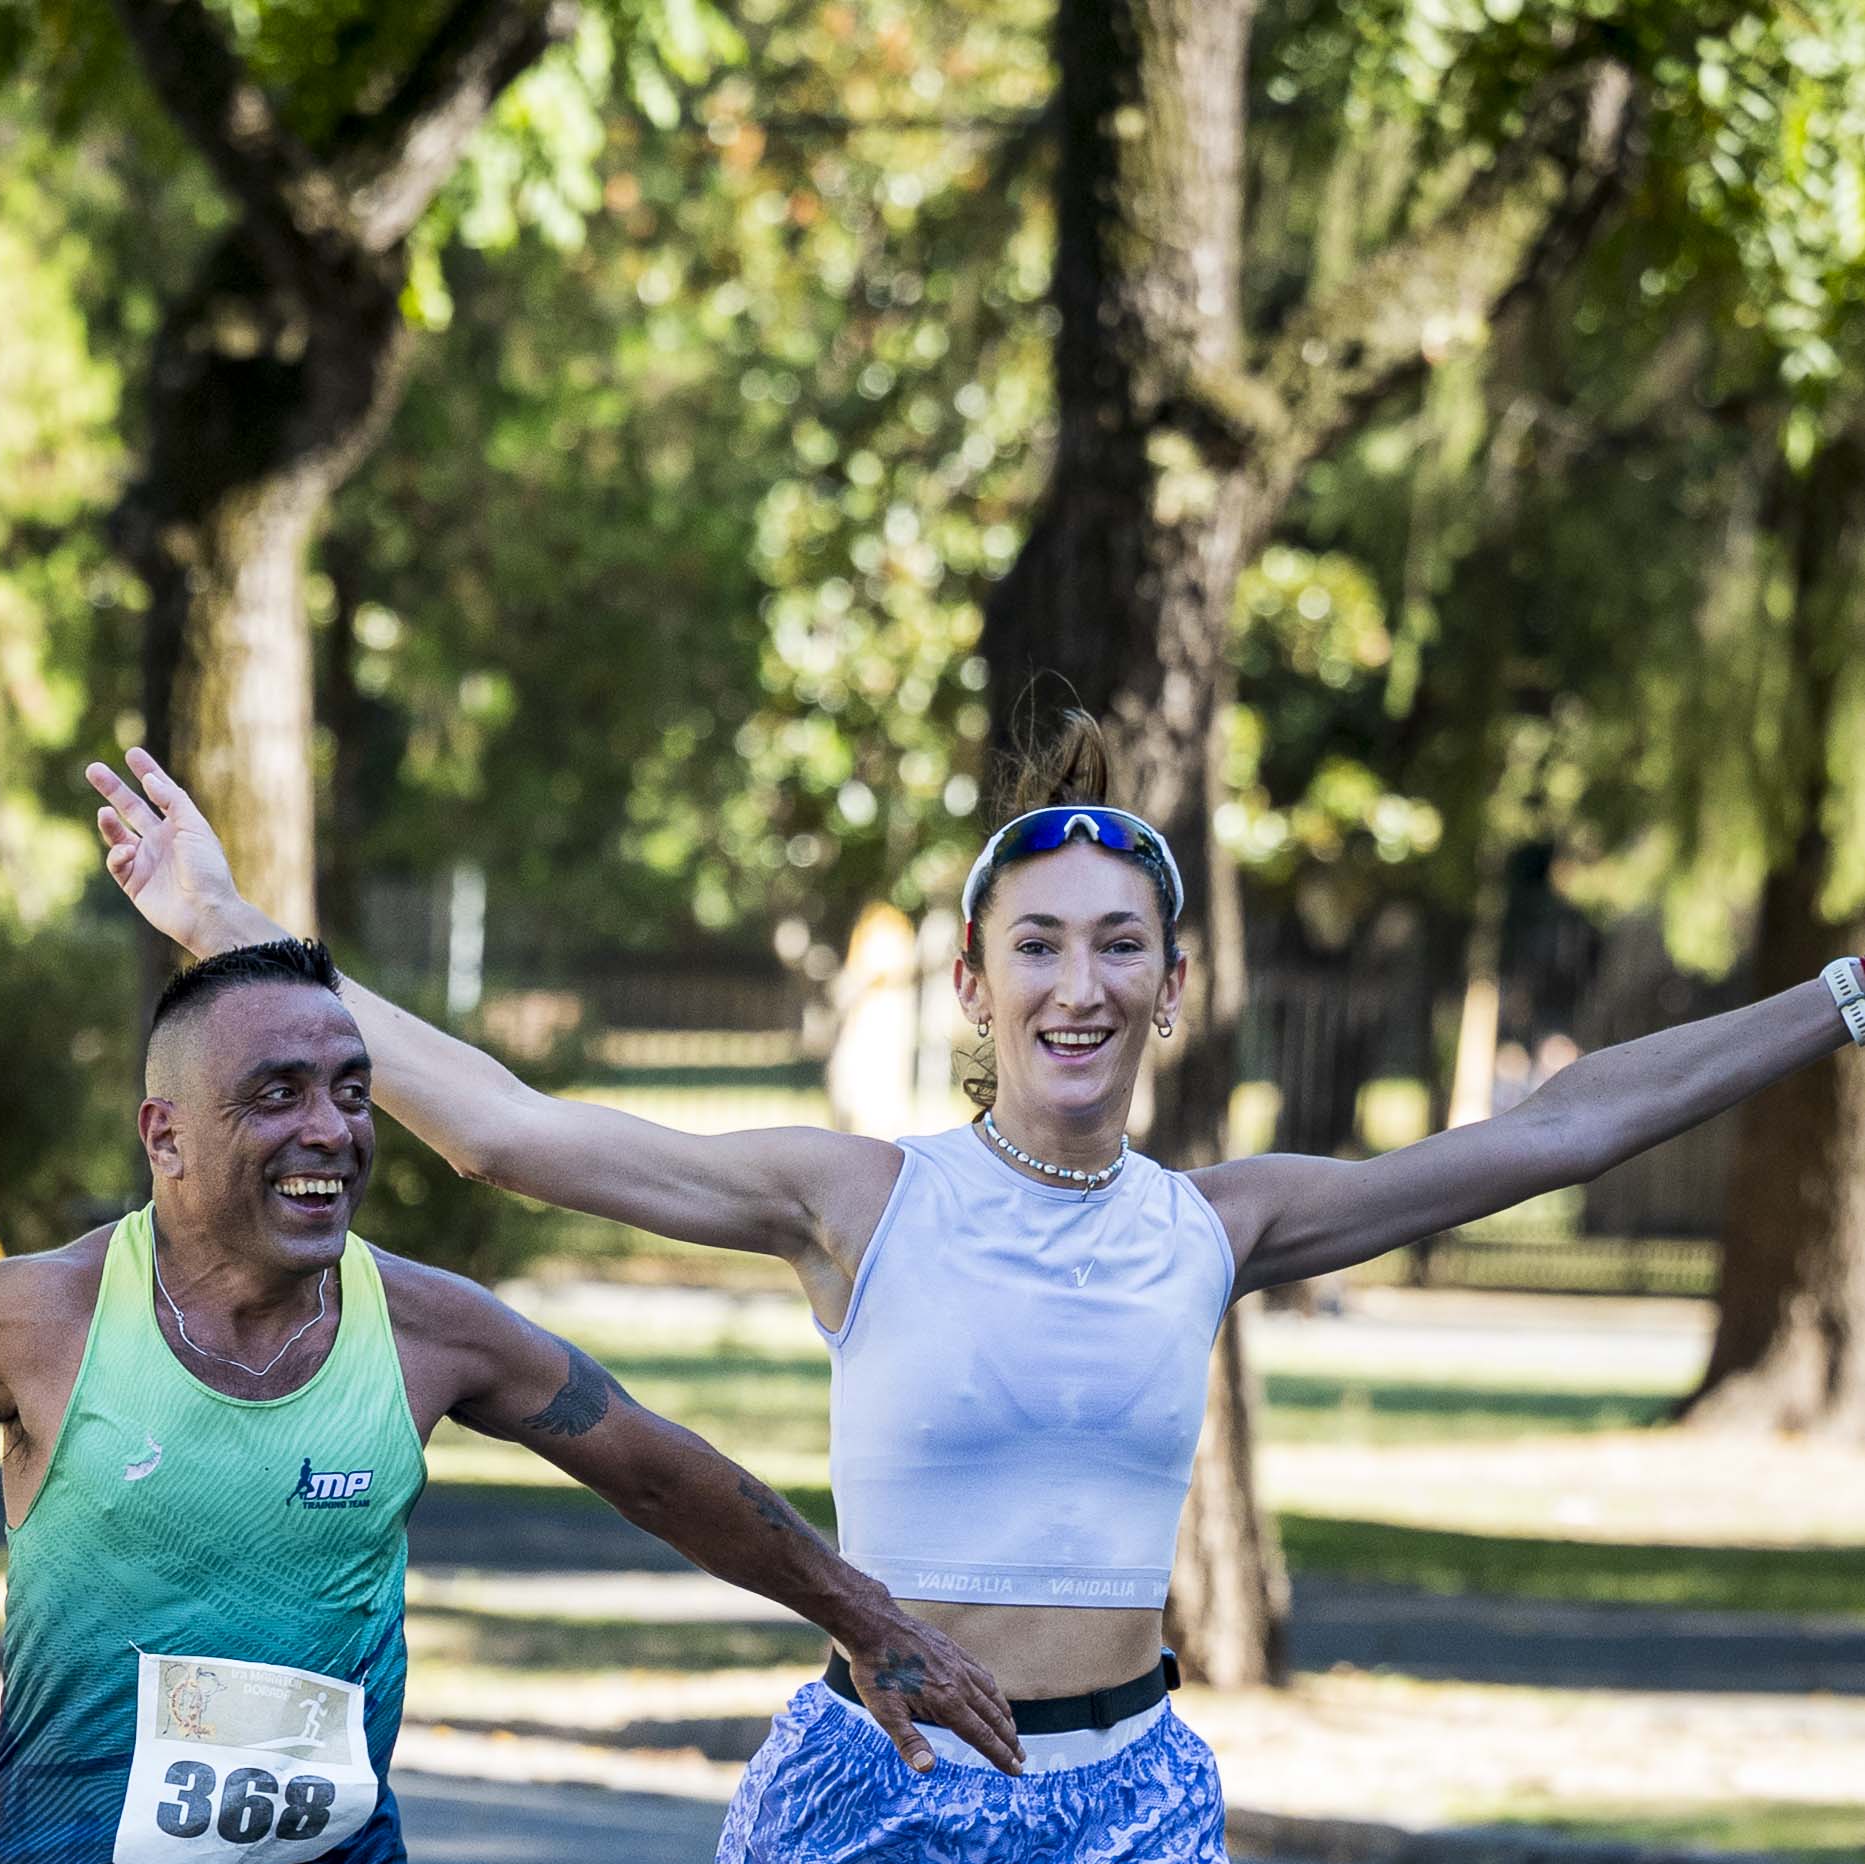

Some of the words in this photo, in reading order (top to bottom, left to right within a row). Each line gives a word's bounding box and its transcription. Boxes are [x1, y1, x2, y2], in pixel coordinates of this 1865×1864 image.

[305, 1470, 374, 1500] MP
[302, 1501, 347, 1510] TRAINING
[349, 1500, 370, 1509] TEAM
[913, 1571, 1014, 1593] VANDALIA
[1048, 1576, 1135, 1597] VANDALIA
[156, 1760, 336, 1845] 368
